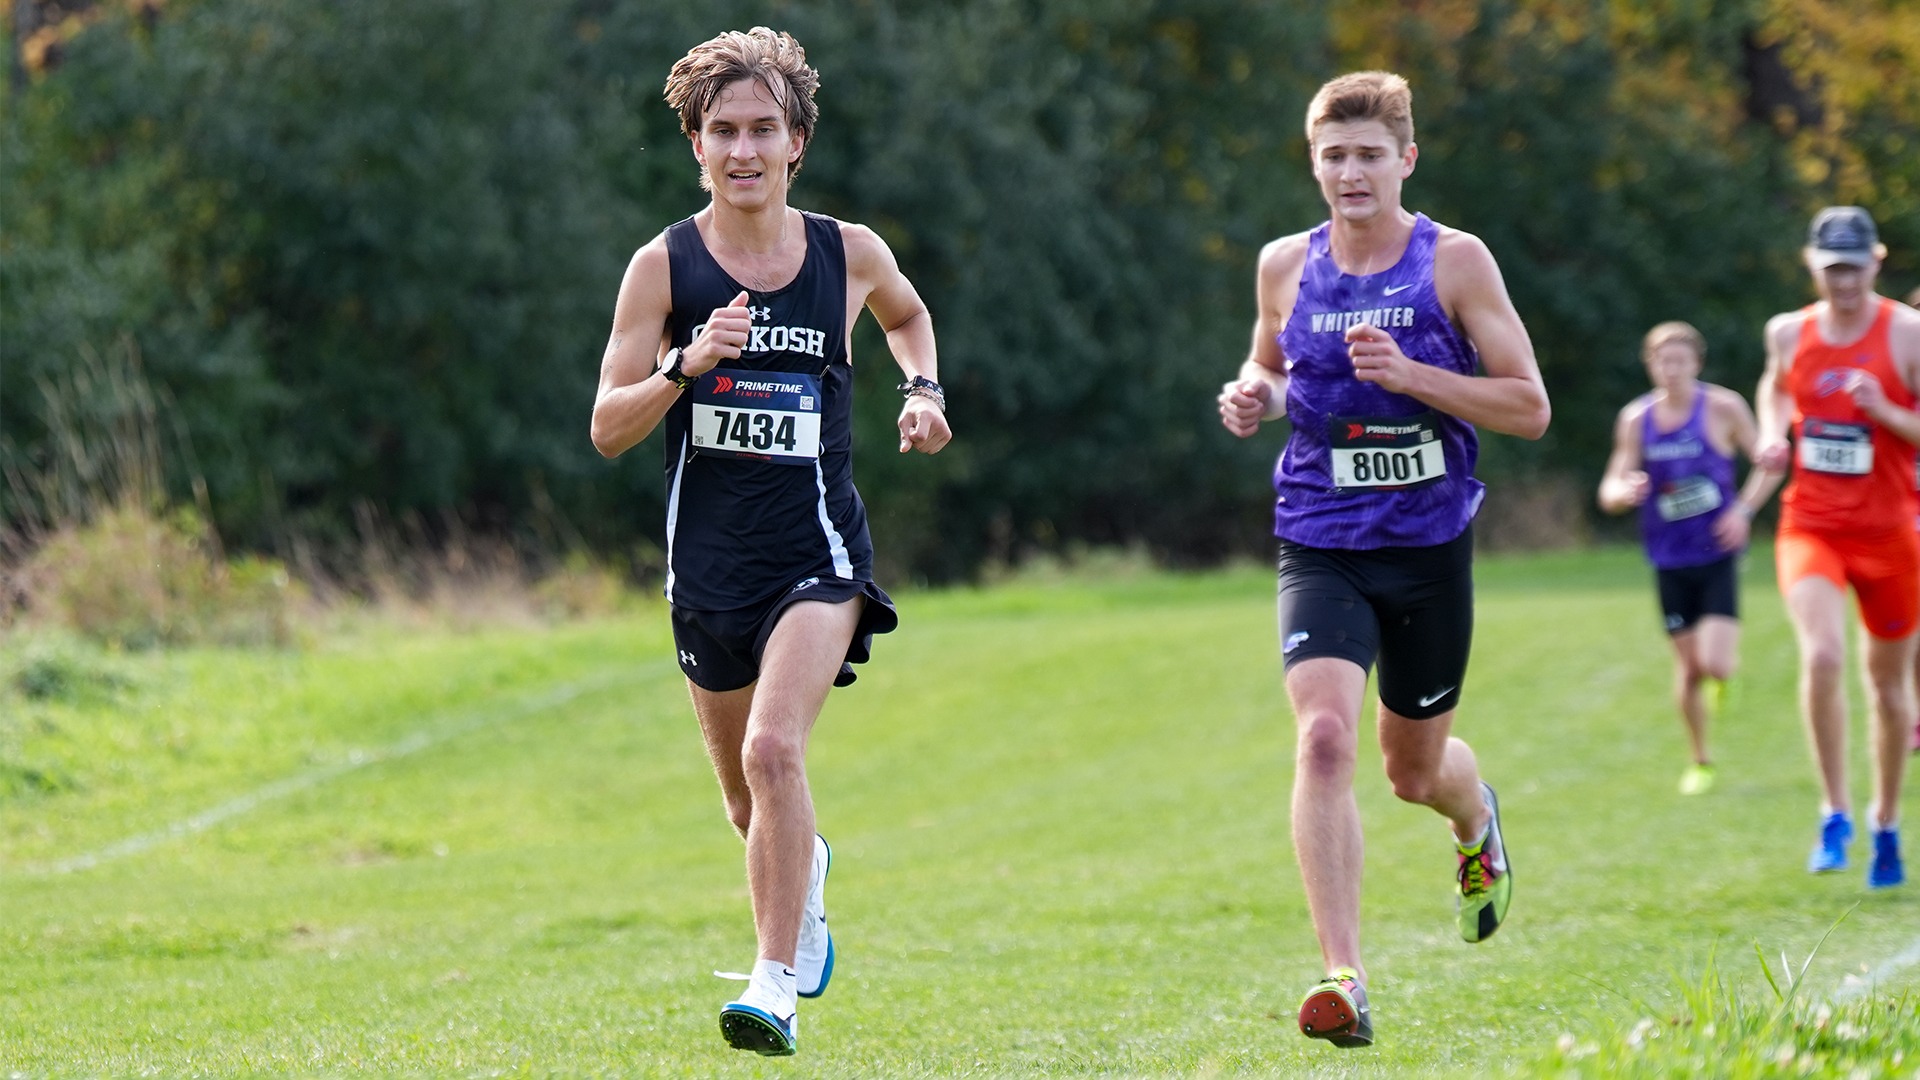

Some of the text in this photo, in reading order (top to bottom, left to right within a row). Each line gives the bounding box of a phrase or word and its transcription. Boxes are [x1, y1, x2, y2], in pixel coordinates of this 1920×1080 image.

[1312, 307, 1415, 333] WHITEWATER
[692, 324, 826, 358] KOSH
[735, 380, 804, 394] PRIMETIME
[735, 390, 771, 399] TIMING
[714, 410, 797, 452] 7434
[1366, 423, 1422, 435] PRIMETIME
[1353, 449, 1426, 482] 8001
